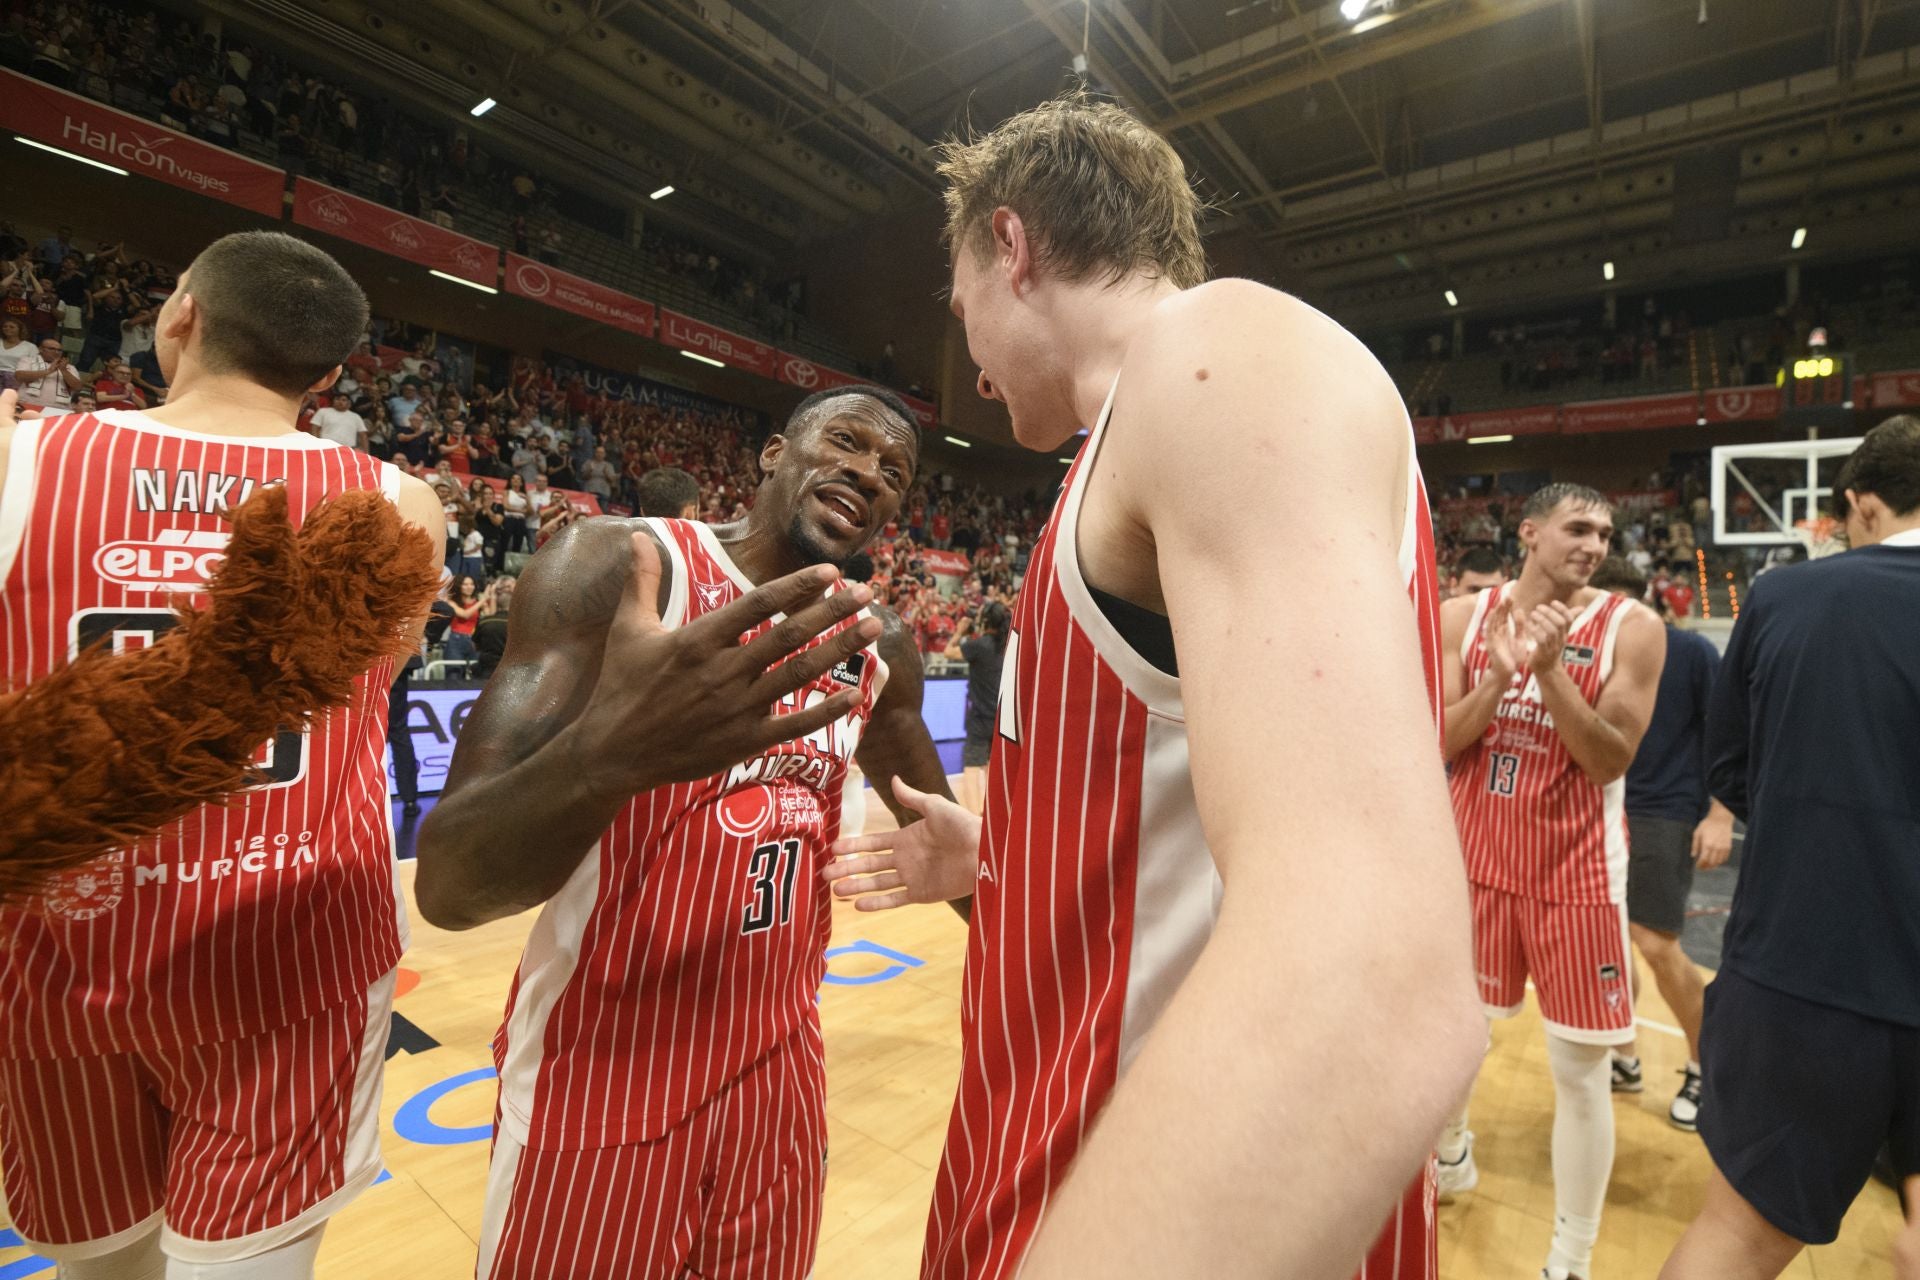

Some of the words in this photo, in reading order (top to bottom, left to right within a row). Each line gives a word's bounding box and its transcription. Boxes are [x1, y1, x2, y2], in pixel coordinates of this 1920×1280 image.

[133, 468, 288, 514] NAKI
[1496, 702, 1554, 730] URCIA
[725, 753, 835, 790] MURCI
[1489, 752, 1520, 797] 13
[780, 812, 795, 825] DE
[234, 831, 313, 853] 1200
[136, 845, 315, 888] MURCIA
[741, 838, 801, 936] 31
